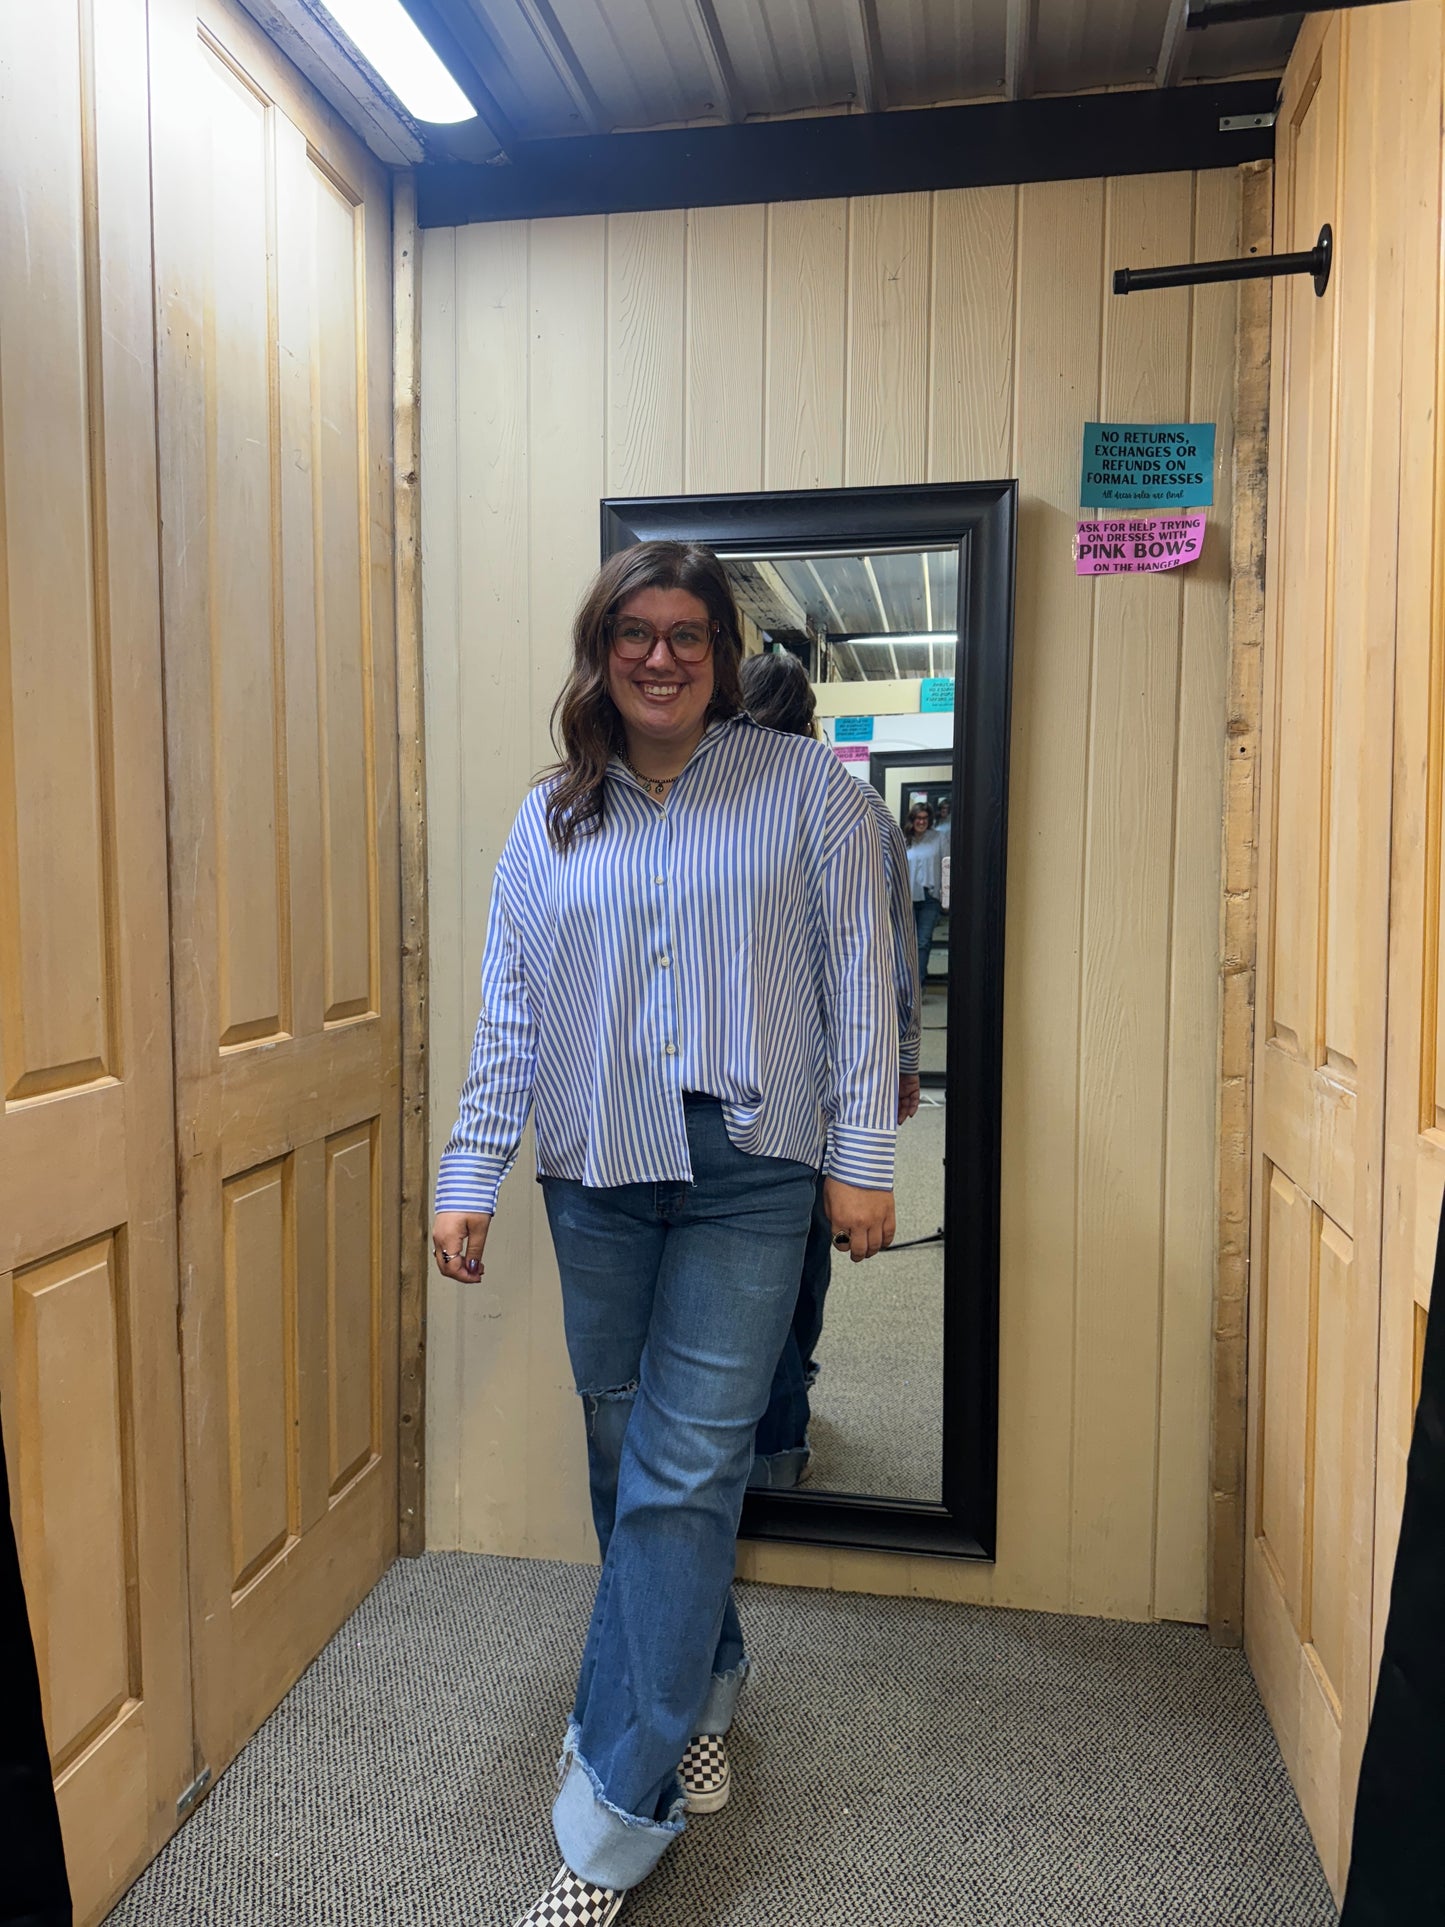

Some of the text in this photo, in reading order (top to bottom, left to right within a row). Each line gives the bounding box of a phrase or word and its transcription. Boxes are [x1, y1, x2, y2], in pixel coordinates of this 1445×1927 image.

[1101, 431, 1190, 445] NO RETURNS,
[1095, 445, 1197, 457] EXCHANGES OR
[1102, 459, 1186, 471] REFUNDS ON
[1087, 472, 1203, 485] FORMAL DRESSES
[1102, 490, 1112, 499] All
[1114, 490, 1132, 499] dress
[1133, 490, 1151, 499] sales
[1166, 490, 1184, 500] final
[1078, 519, 1201, 533] ASK FOR HELP TRYING
[1088, 531, 1187, 543] ON DRESSES WITH
[1079, 538, 1197, 560] PINK BOWS
[1093, 558, 1180, 572] ON THE HANGER
